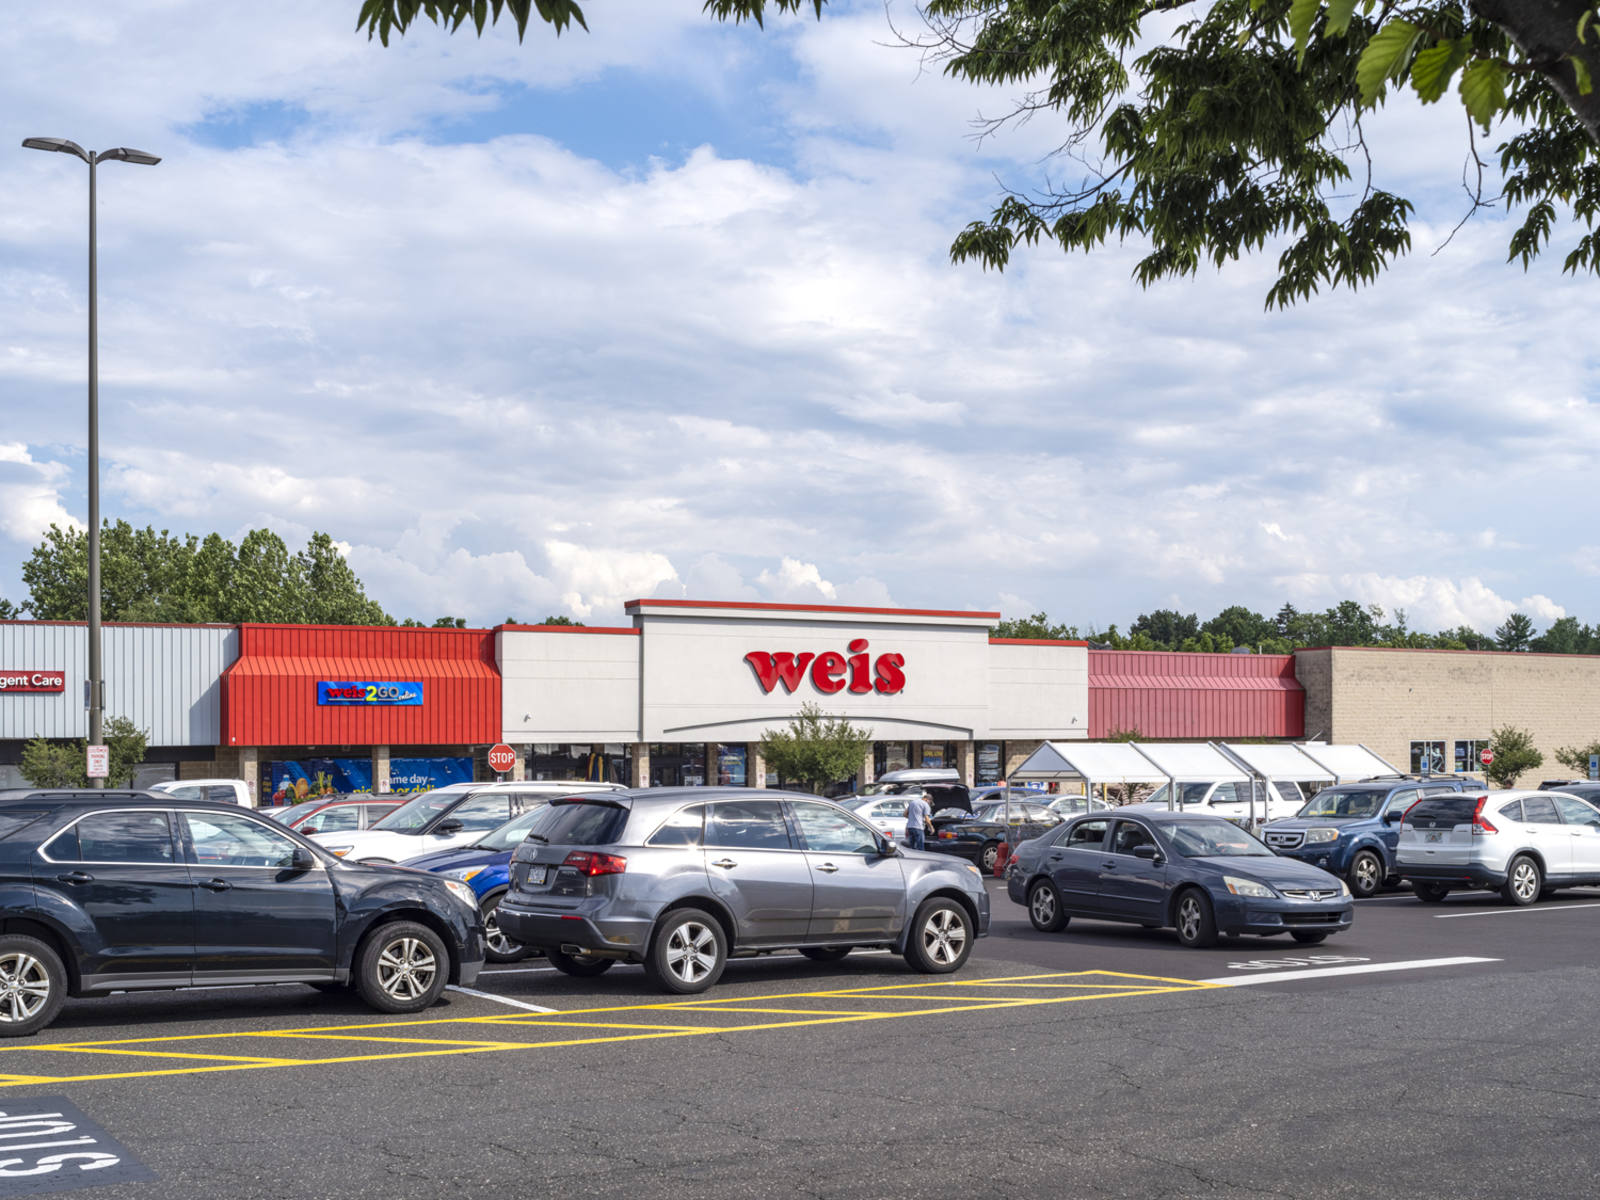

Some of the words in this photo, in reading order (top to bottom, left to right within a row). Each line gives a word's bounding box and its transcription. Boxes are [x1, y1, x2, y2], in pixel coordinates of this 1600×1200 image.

[744, 638, 906, 694] weis
[31, 673, 63, 686] Care
[490, 752, 514, 764] STOP
[389, 775, 409, 784] ame
